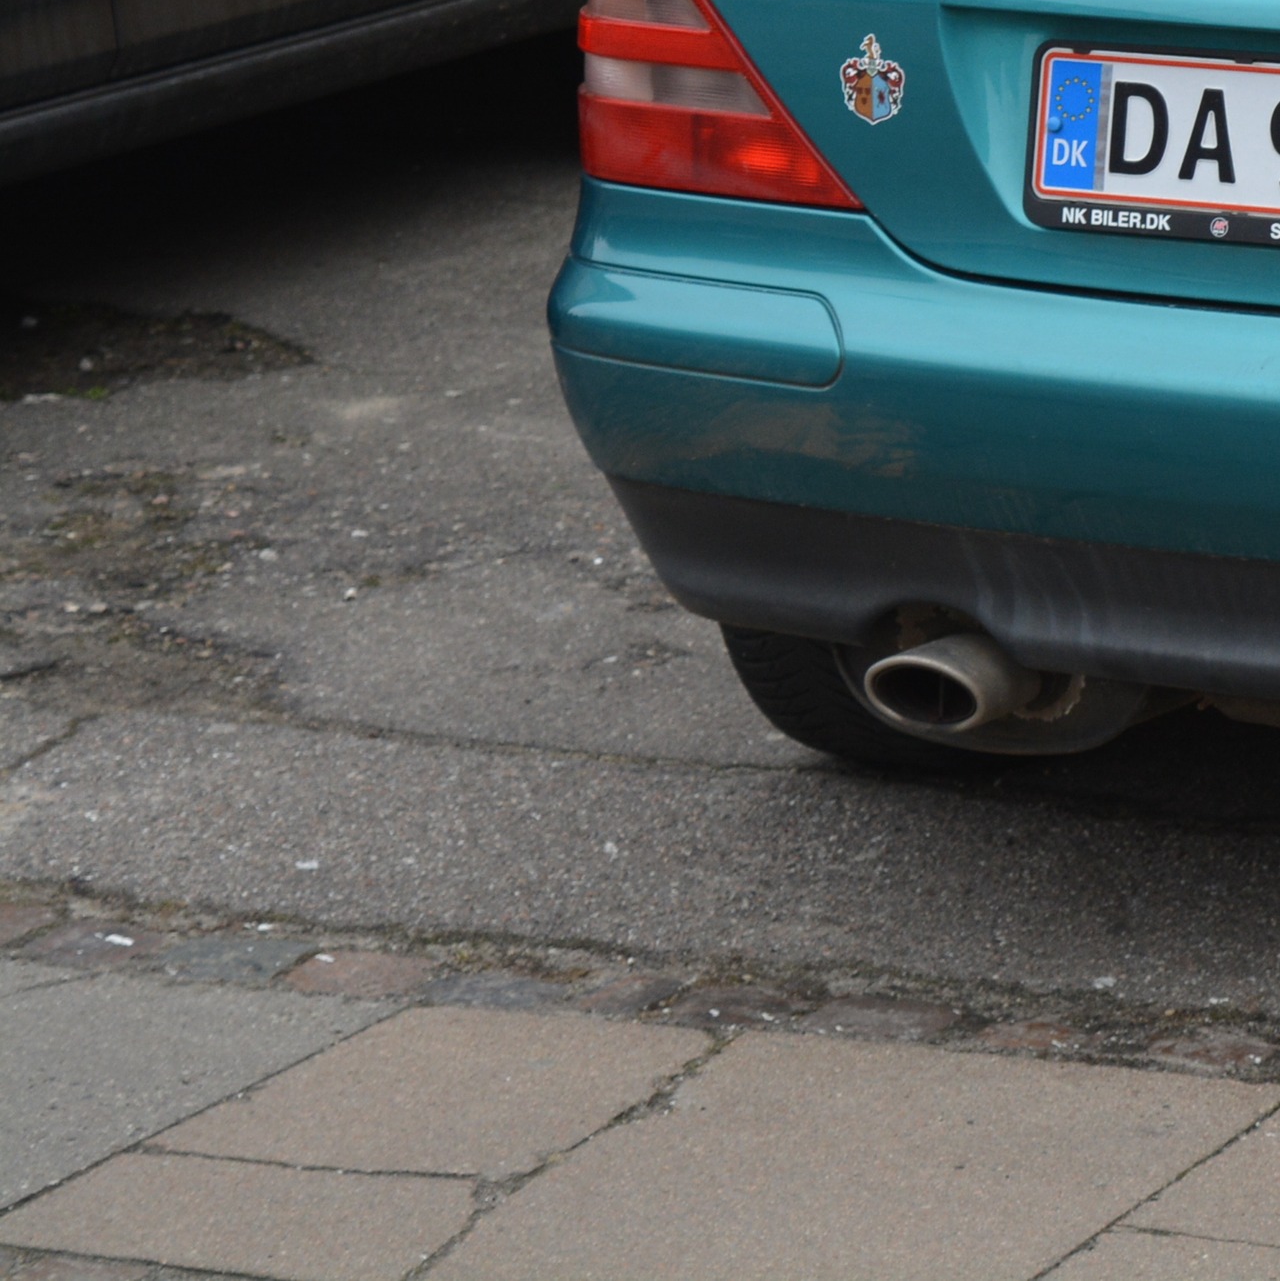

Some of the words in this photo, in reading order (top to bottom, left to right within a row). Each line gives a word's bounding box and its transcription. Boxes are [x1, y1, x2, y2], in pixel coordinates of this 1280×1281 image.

[1109, 81, 1236, 183] DA
[1051, 137, 1088, 168] DK
[1061, 206, 1087, 225] NK
[1090, 209, 1171, 231] BILER.DK
